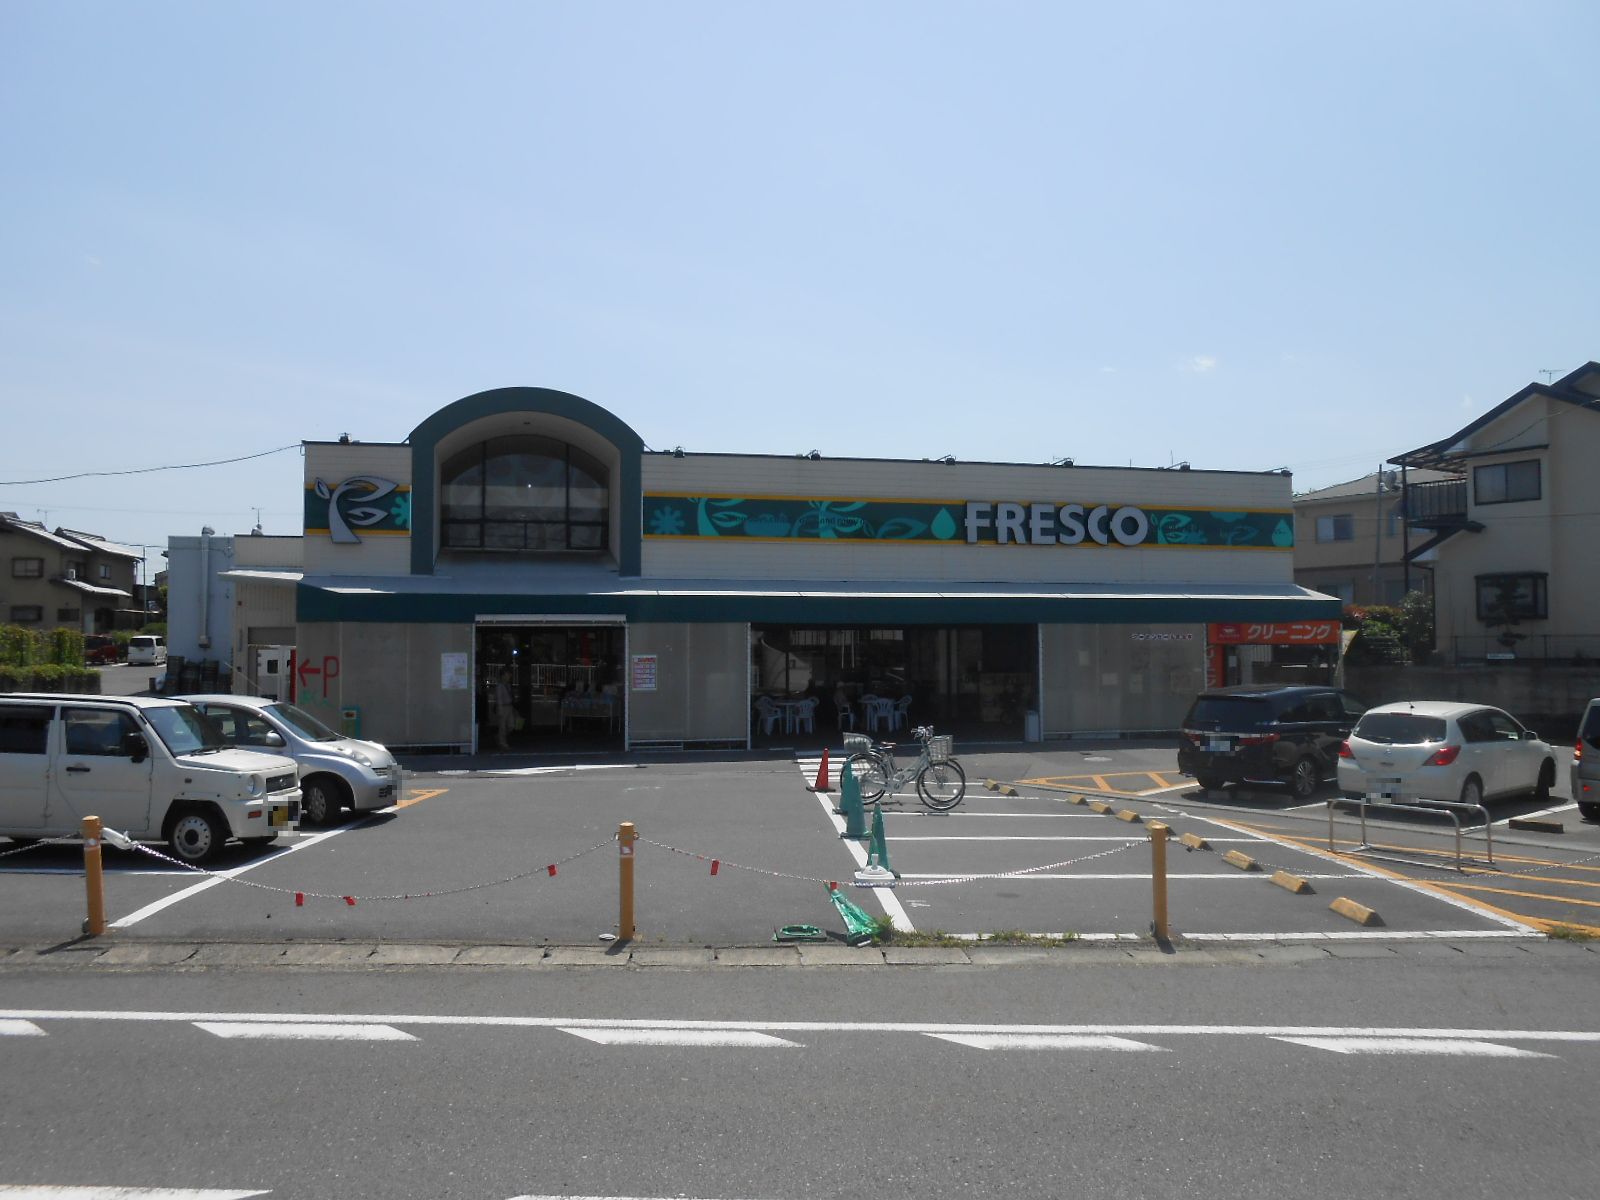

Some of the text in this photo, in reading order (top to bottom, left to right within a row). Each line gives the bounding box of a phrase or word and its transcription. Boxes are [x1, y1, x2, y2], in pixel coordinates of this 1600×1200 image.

[964, 501, 1149, 546] FRESCO
[1247, 623, 1332, 641] クリーニング
